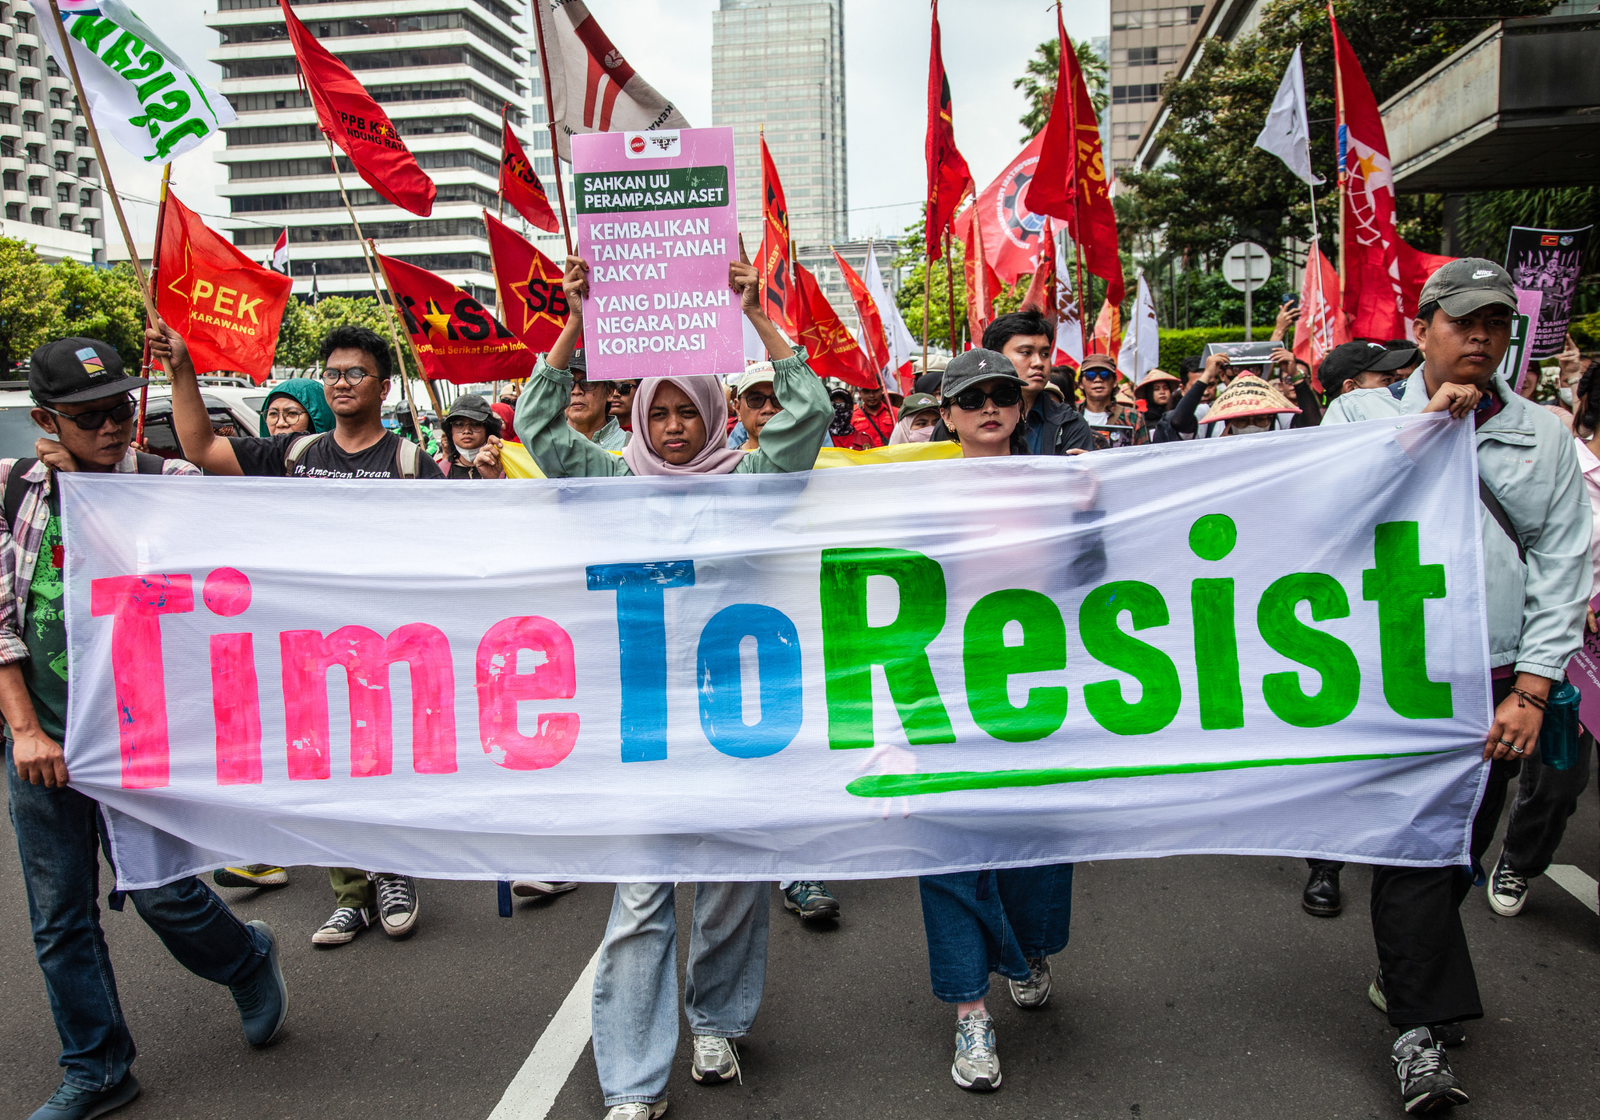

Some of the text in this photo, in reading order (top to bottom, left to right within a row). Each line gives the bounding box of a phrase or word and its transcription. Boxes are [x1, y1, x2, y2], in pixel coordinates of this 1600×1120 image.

[337, 110, 366, 130] PPB
[644, 104, 674, 131] KEMA
[583, 173, 670, 191] SAHKAN UU
[584, 187, 724, 208] PERAMPASAN ASET
[590, 217, 710, 241] KEMBALIKAN
[590, 238, 727, 262] TANAH-TANAH
[593, 263, 668, 283] RAKYAT
[594, 289, 730, 313] YANG DIJARAH
[190, 310, 256, 336] KARAWANG
[596, 311, 717, 334] NEGARA DAN
[447, 344, 481, 355] Serikat
[483, 343, 509, 354] Buruh
[509, 339, 529, 351] Indo
[598, 333, 706, 355] KORPORASI
[306, 466, 353, 479] American
[355, 469, 391, 479] Dream
[91, 513, 1453, 790] Time To Resist
